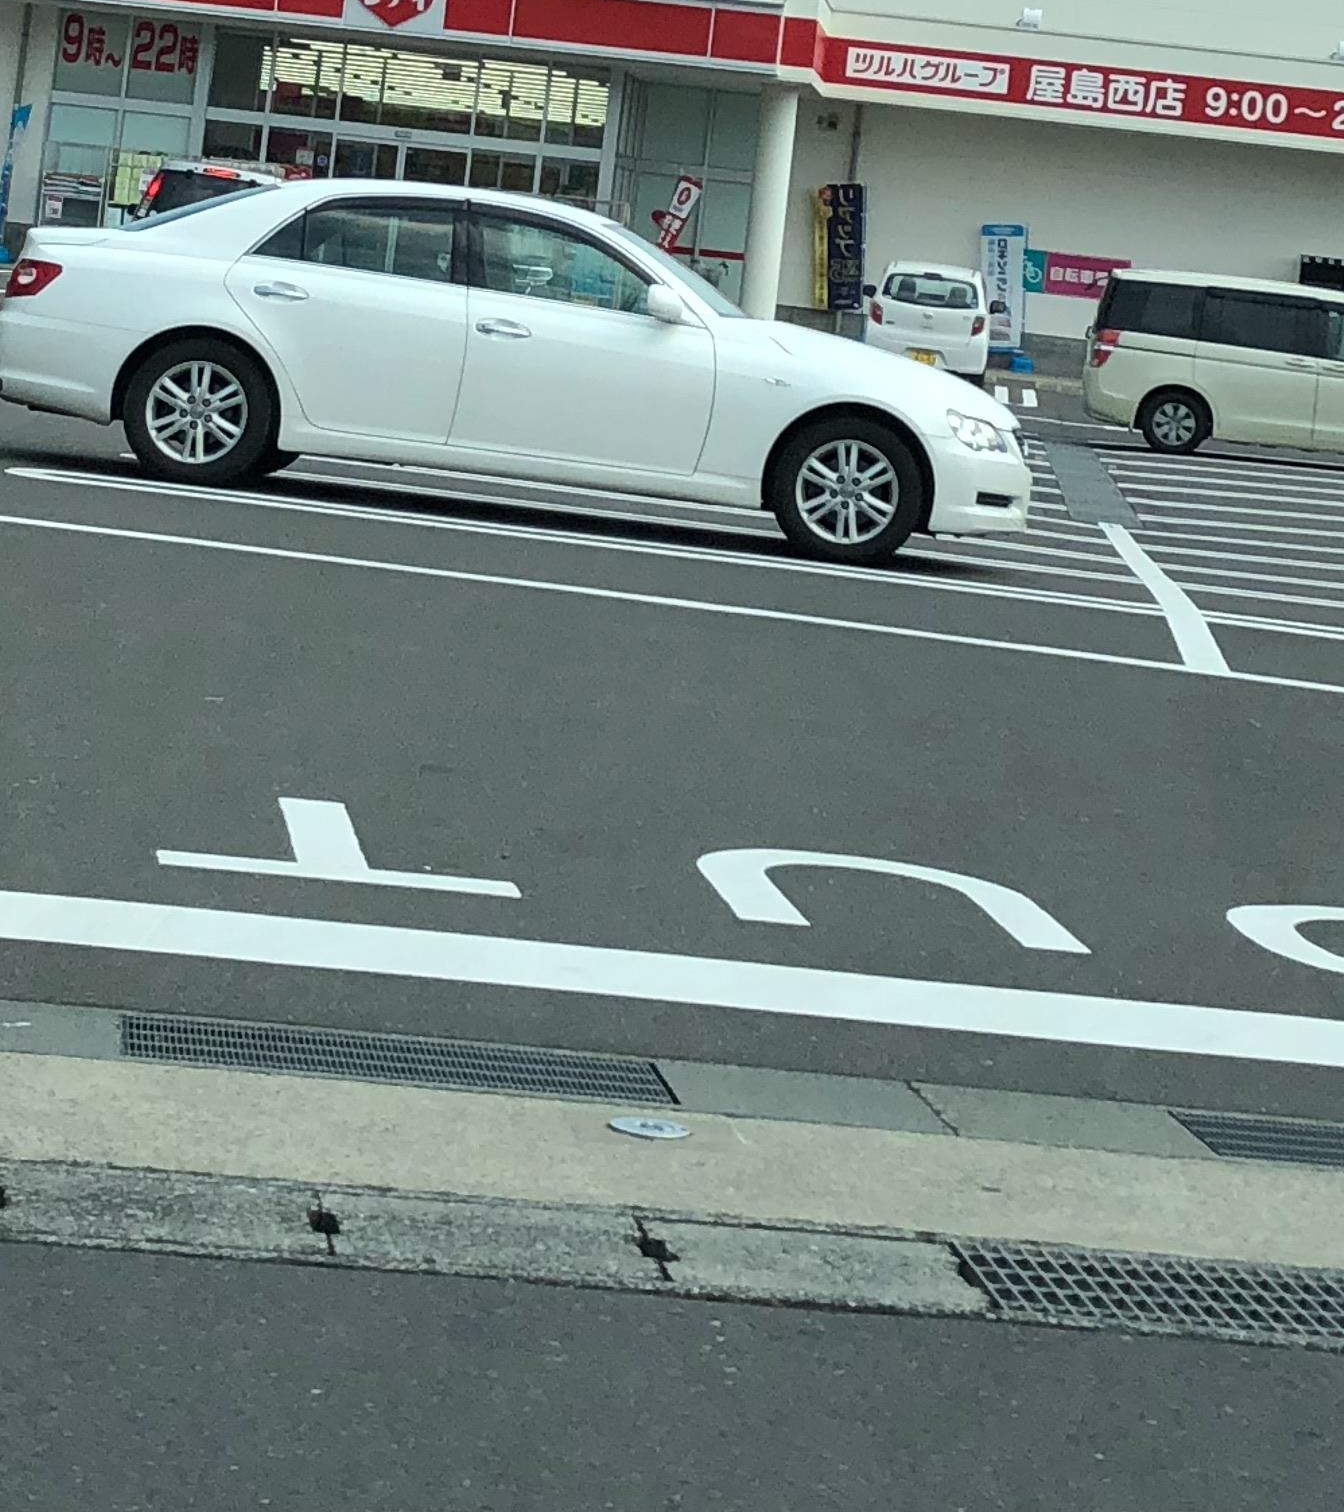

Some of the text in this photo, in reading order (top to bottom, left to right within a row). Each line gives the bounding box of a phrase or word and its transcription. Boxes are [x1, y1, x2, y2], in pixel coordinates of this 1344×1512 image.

[852, 51, 1007, 88] ツルハグループ
[1025, 63, 1188, 118] 屋島西店
